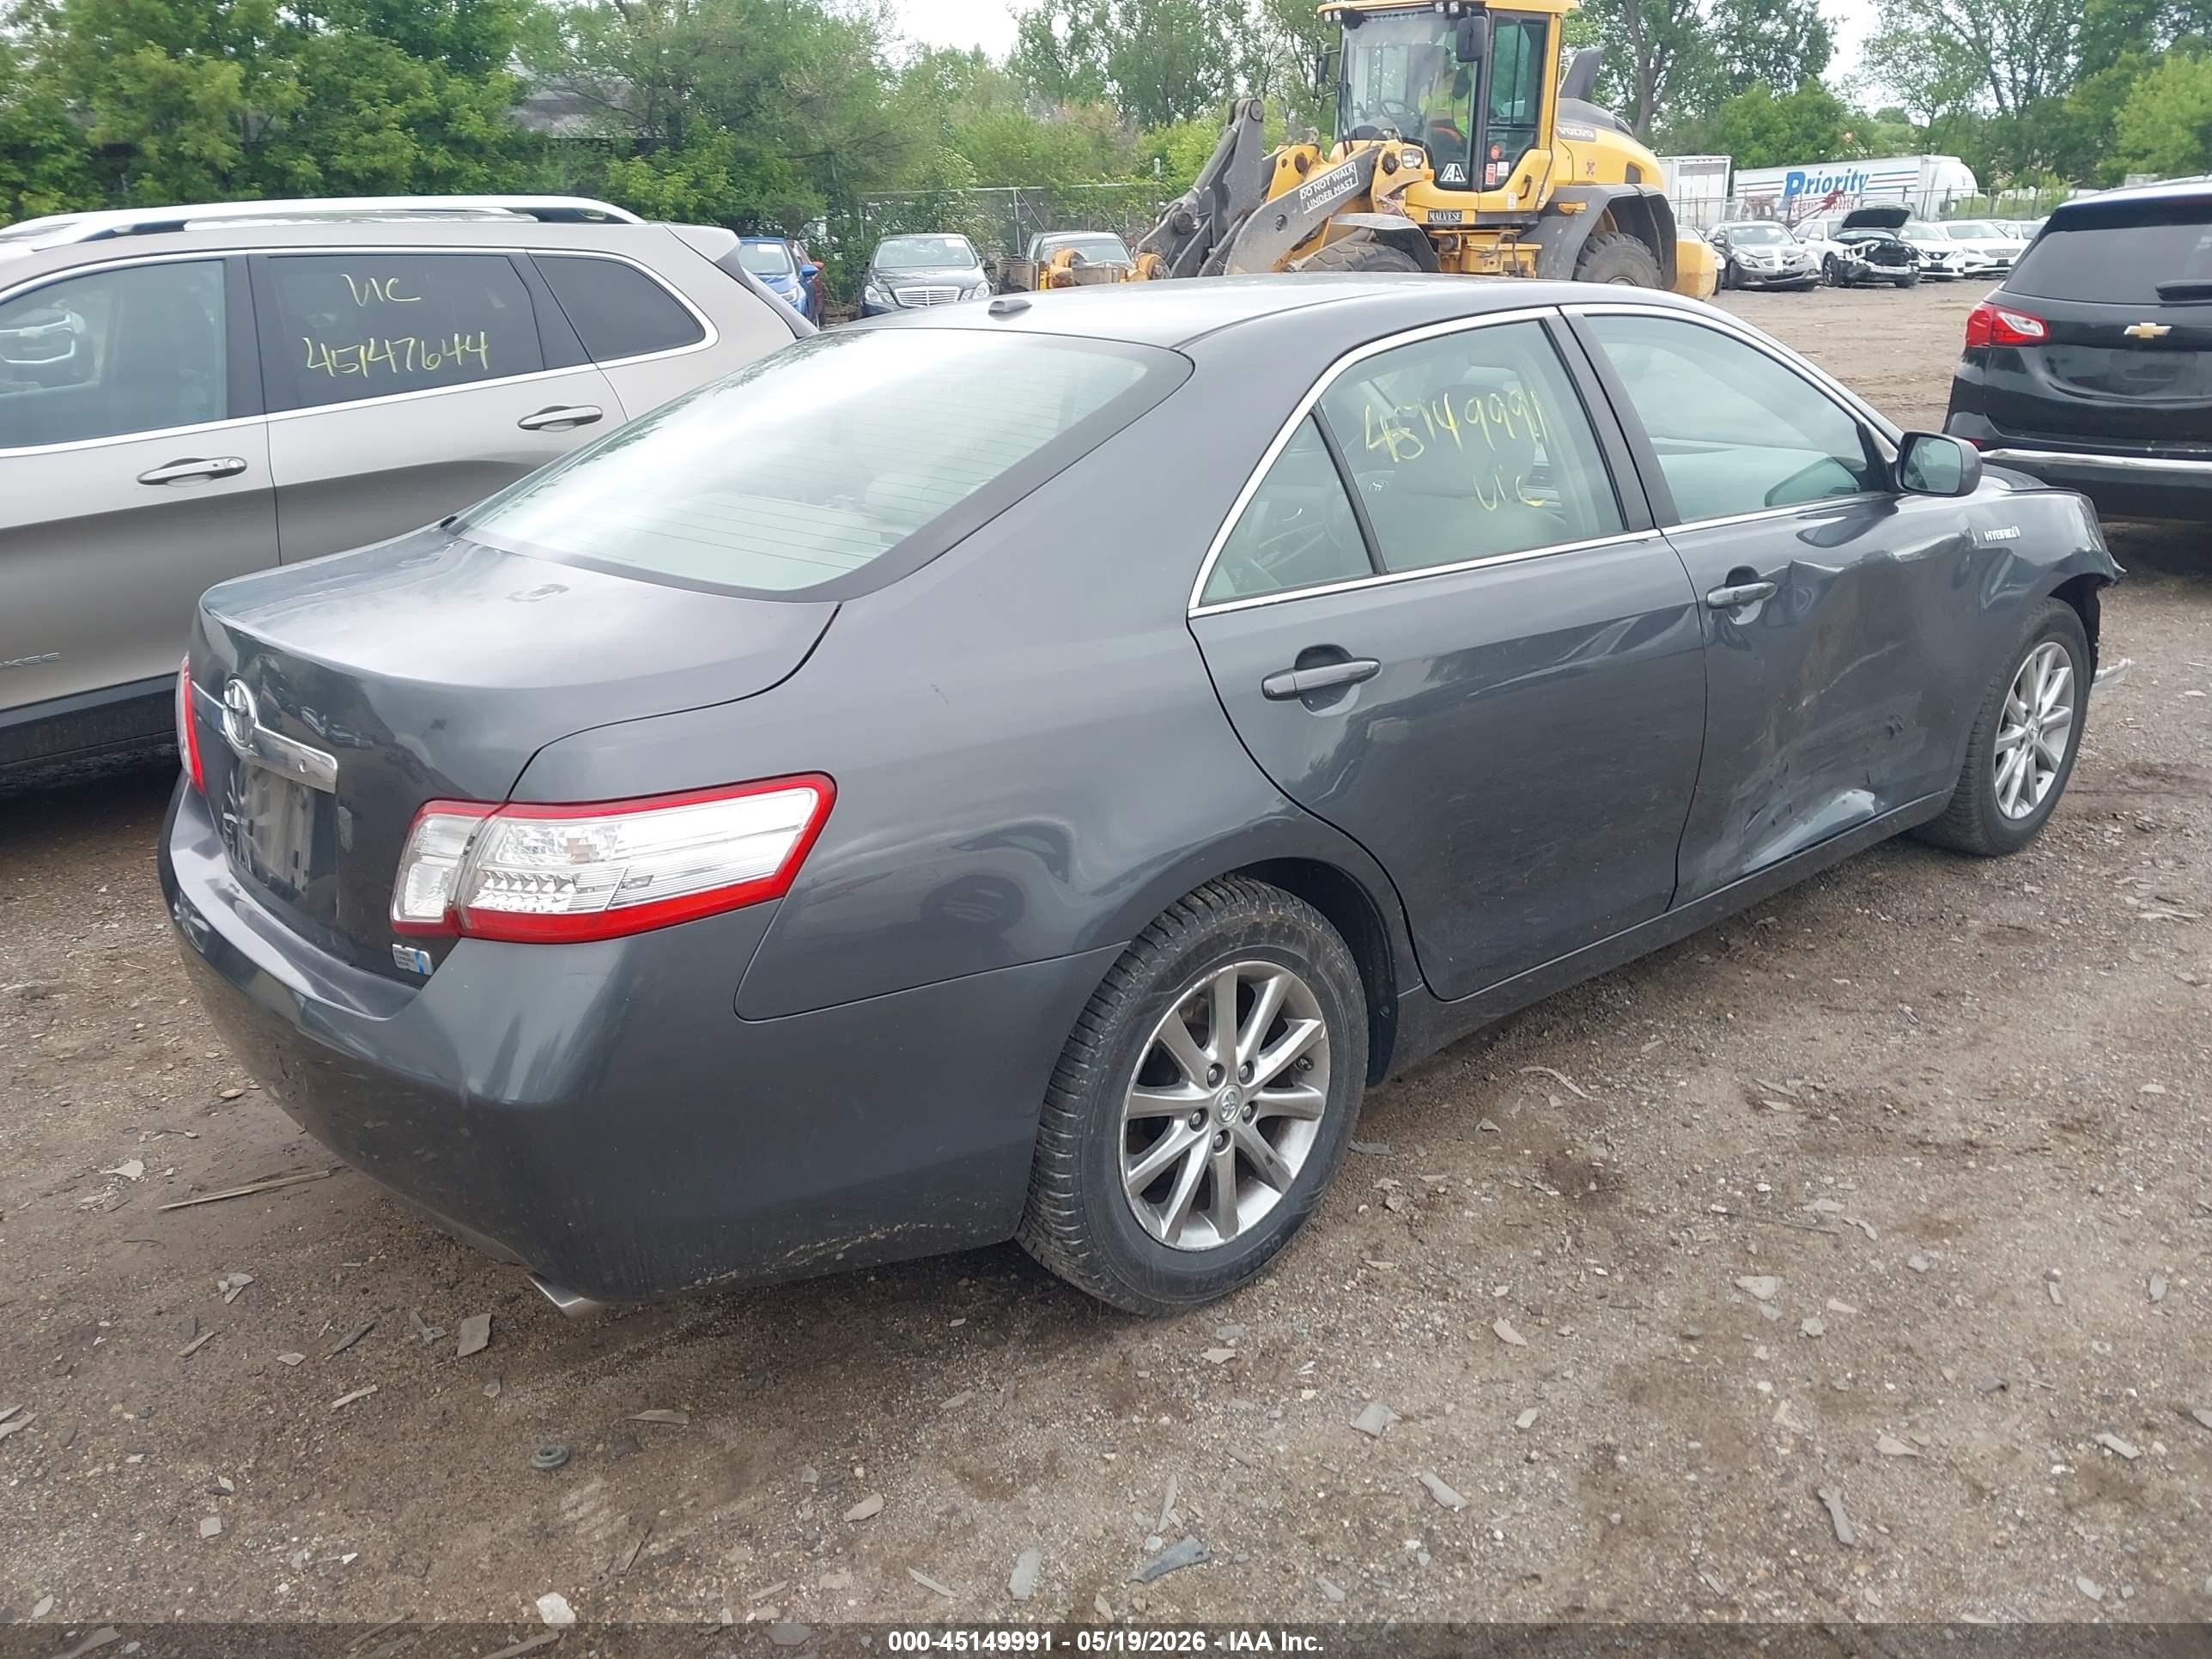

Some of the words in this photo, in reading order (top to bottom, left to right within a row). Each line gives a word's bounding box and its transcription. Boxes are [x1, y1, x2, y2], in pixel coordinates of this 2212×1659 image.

[1556, 126, 1595, 137] VOLVO
[1300, 186, 1313, 199] DO
[1313, 178, 1332, 192] NOT
[1330, 163, 1354, 182] WALK
[1306, 190, 1334, 209] UNDER
[1333, 178, 1354, 194] MAST
[1781, 167, 1871, 210] Priority
[1429, 210, 1462, 222] MALVESE
[302, 330, 489, 379] 45147644
[1984, 526, 2021, 542] HYBRID
